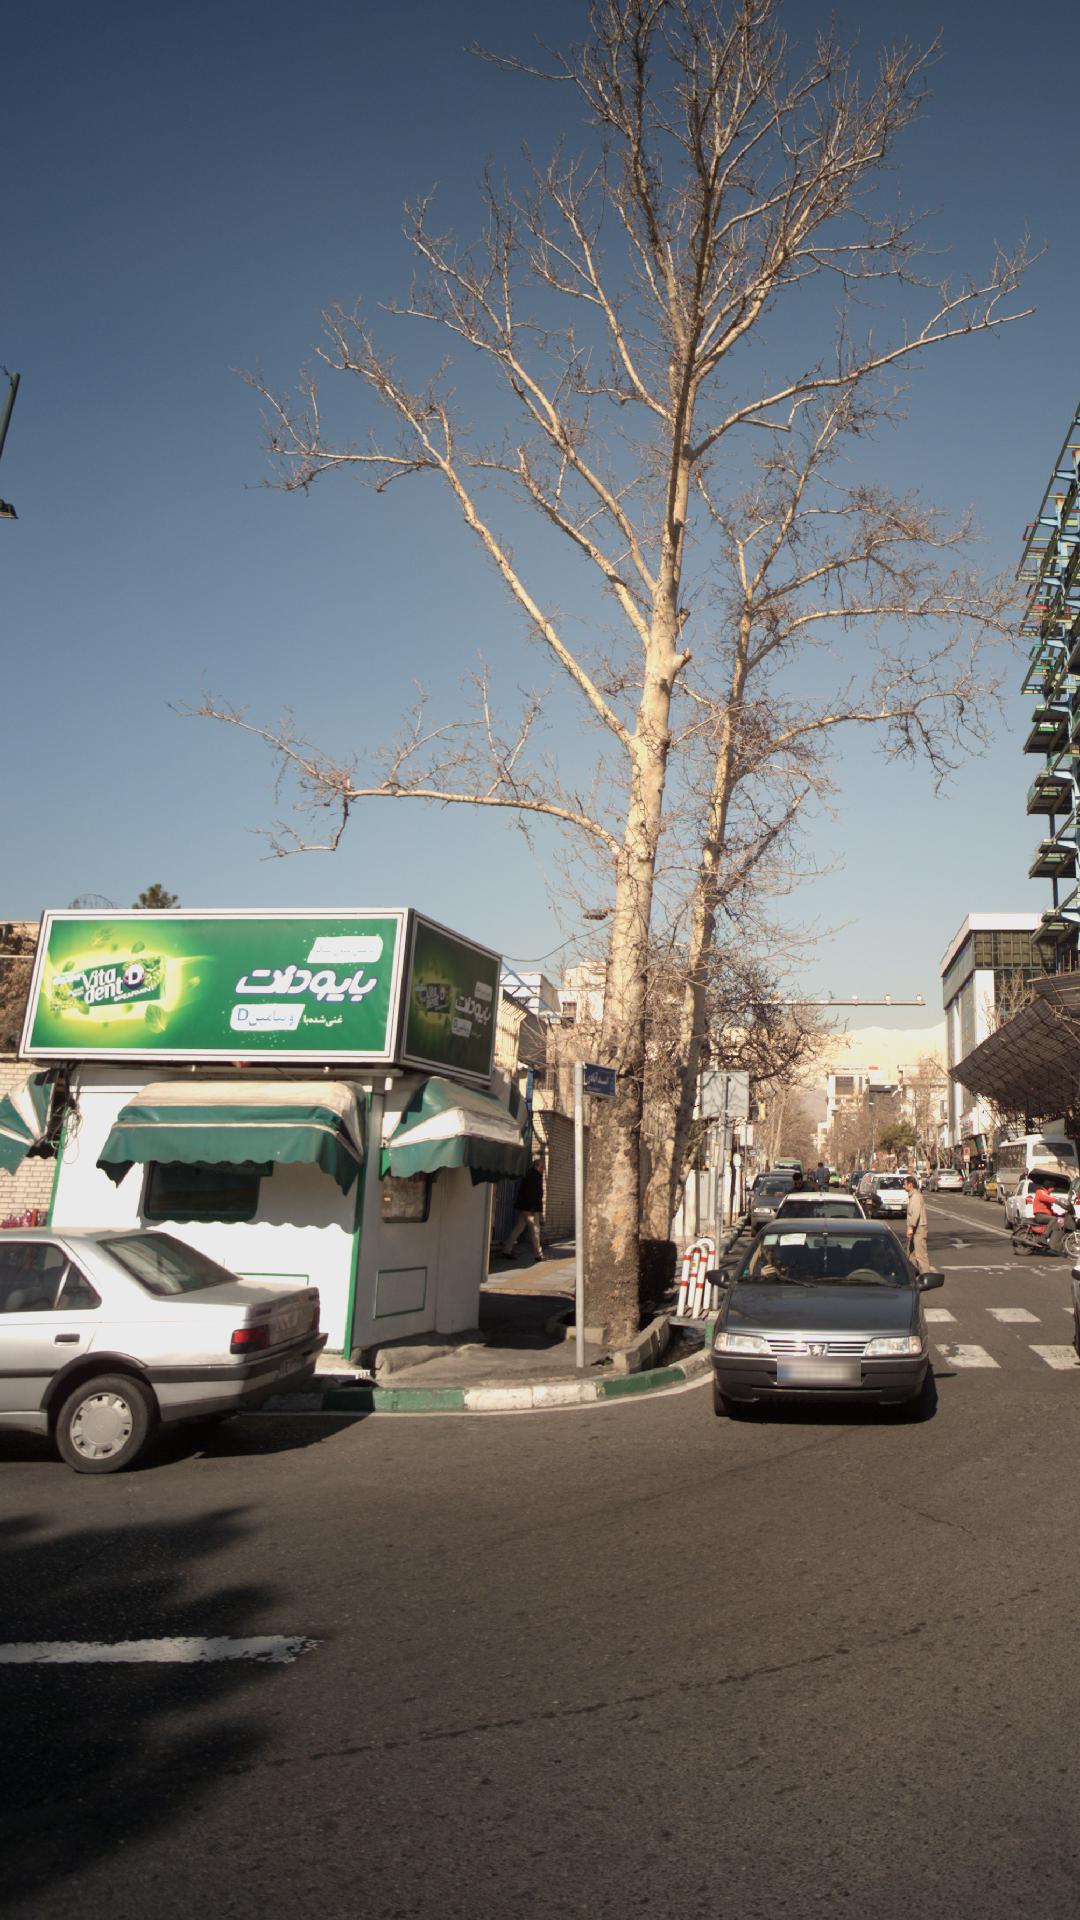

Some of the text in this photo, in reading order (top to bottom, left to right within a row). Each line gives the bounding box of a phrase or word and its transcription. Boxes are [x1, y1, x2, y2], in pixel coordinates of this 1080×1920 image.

[82, 968, 116, 990] Vita
[128, 964, 145, 985] D
[84, 977, 124, 1004] dent
